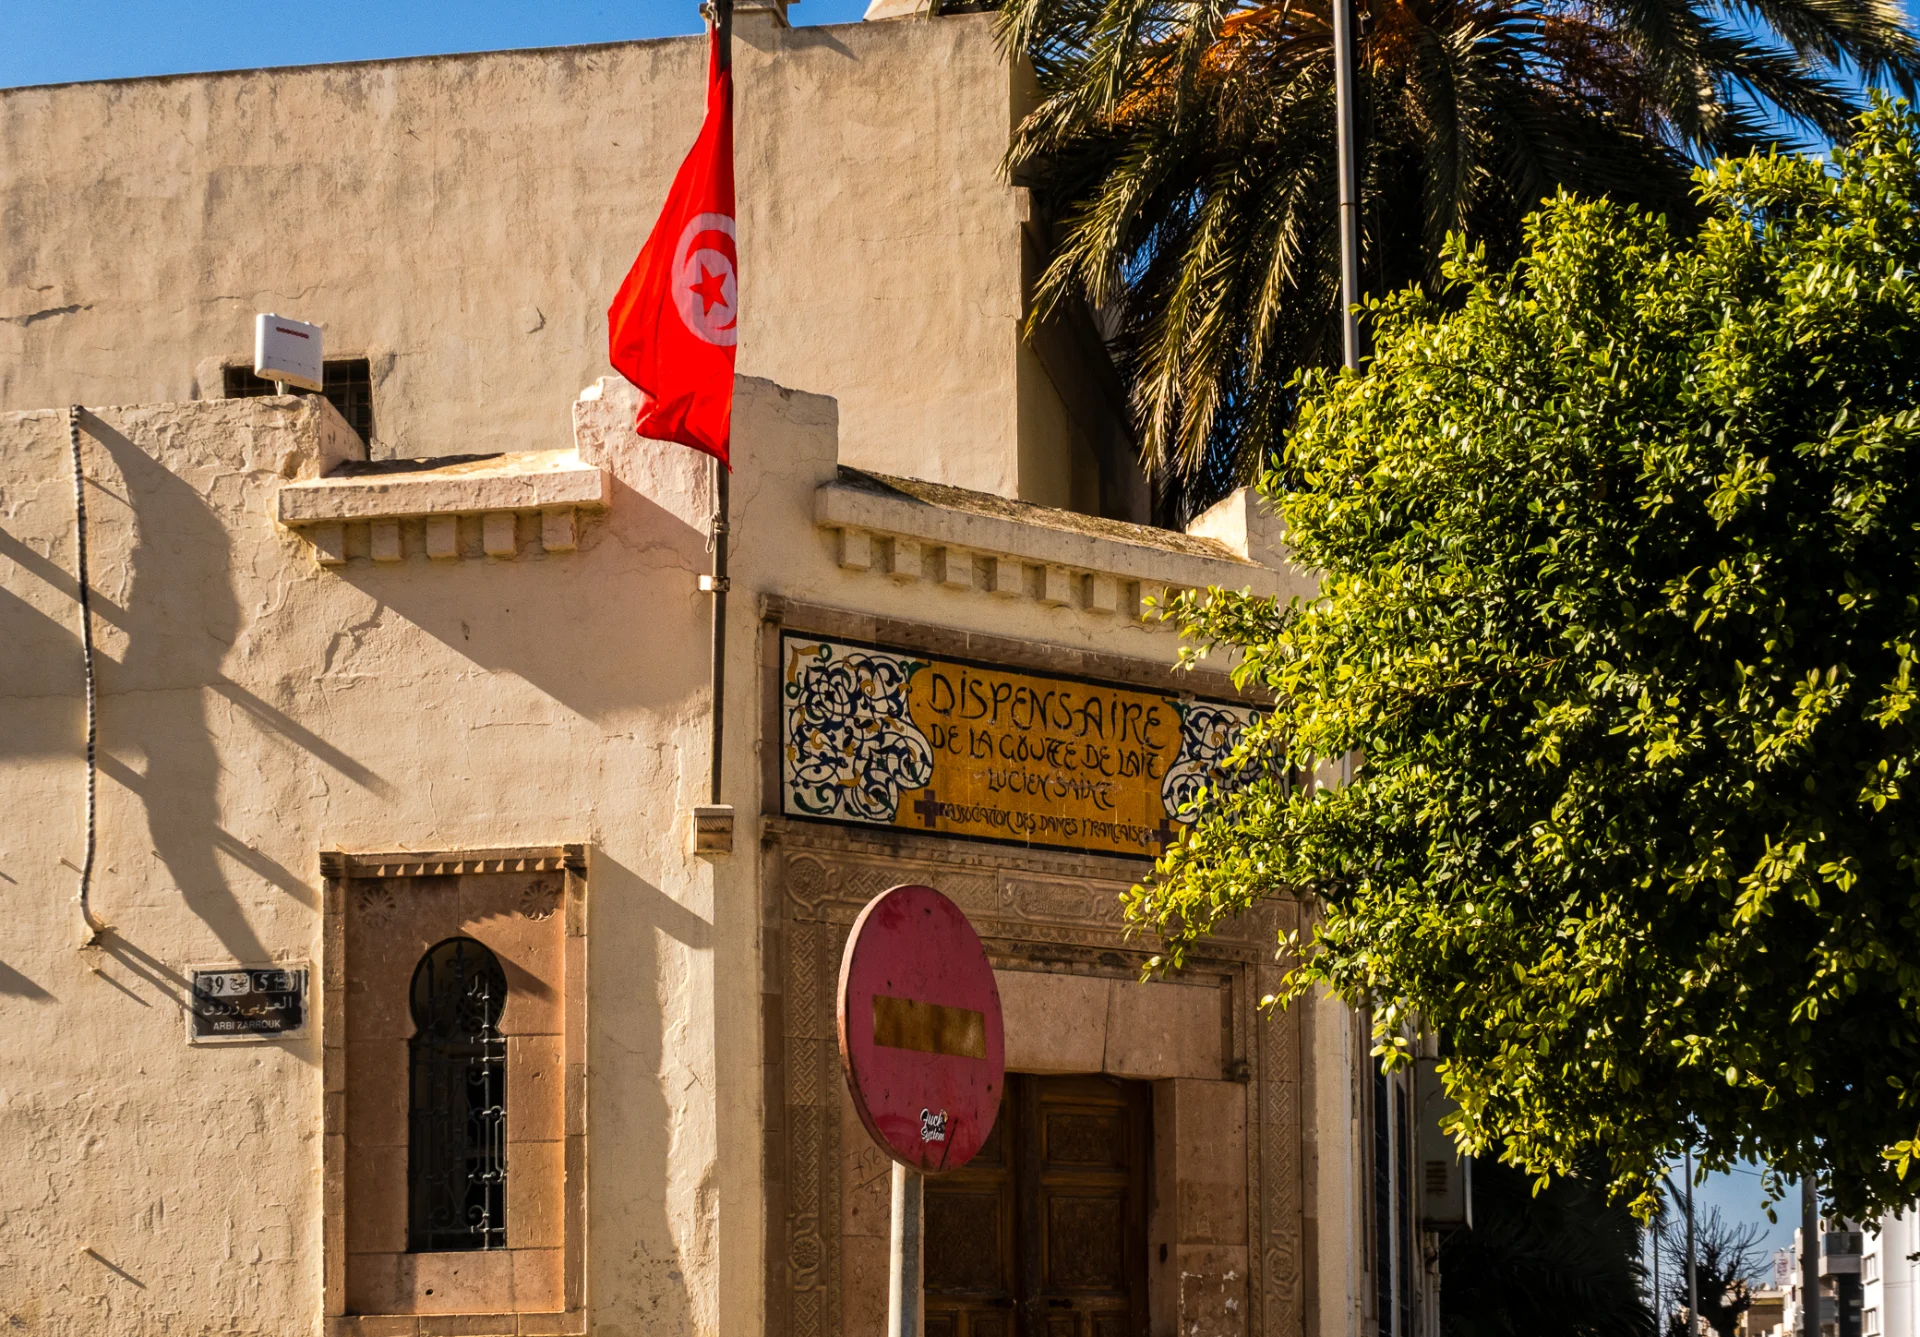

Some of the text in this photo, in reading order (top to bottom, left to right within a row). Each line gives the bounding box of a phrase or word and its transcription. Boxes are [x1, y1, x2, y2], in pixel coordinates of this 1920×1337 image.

[926, 670, 1166, 750] DISPENSAIRE
[930, 723, 1161, 780] DE LA GOUTTE DE LAIT
[988, 766, 1052, 803] LUCIEN
[1015, 811, 1037, 834] DES
[1038, 814, 1079, 840] DAMES
[1081, 817, 1150, 848] FRANÇAISE
[202, 996, 292, 1019] العربي زروق
[213, 1020, 281, 1030] ARBI ZARROUK
